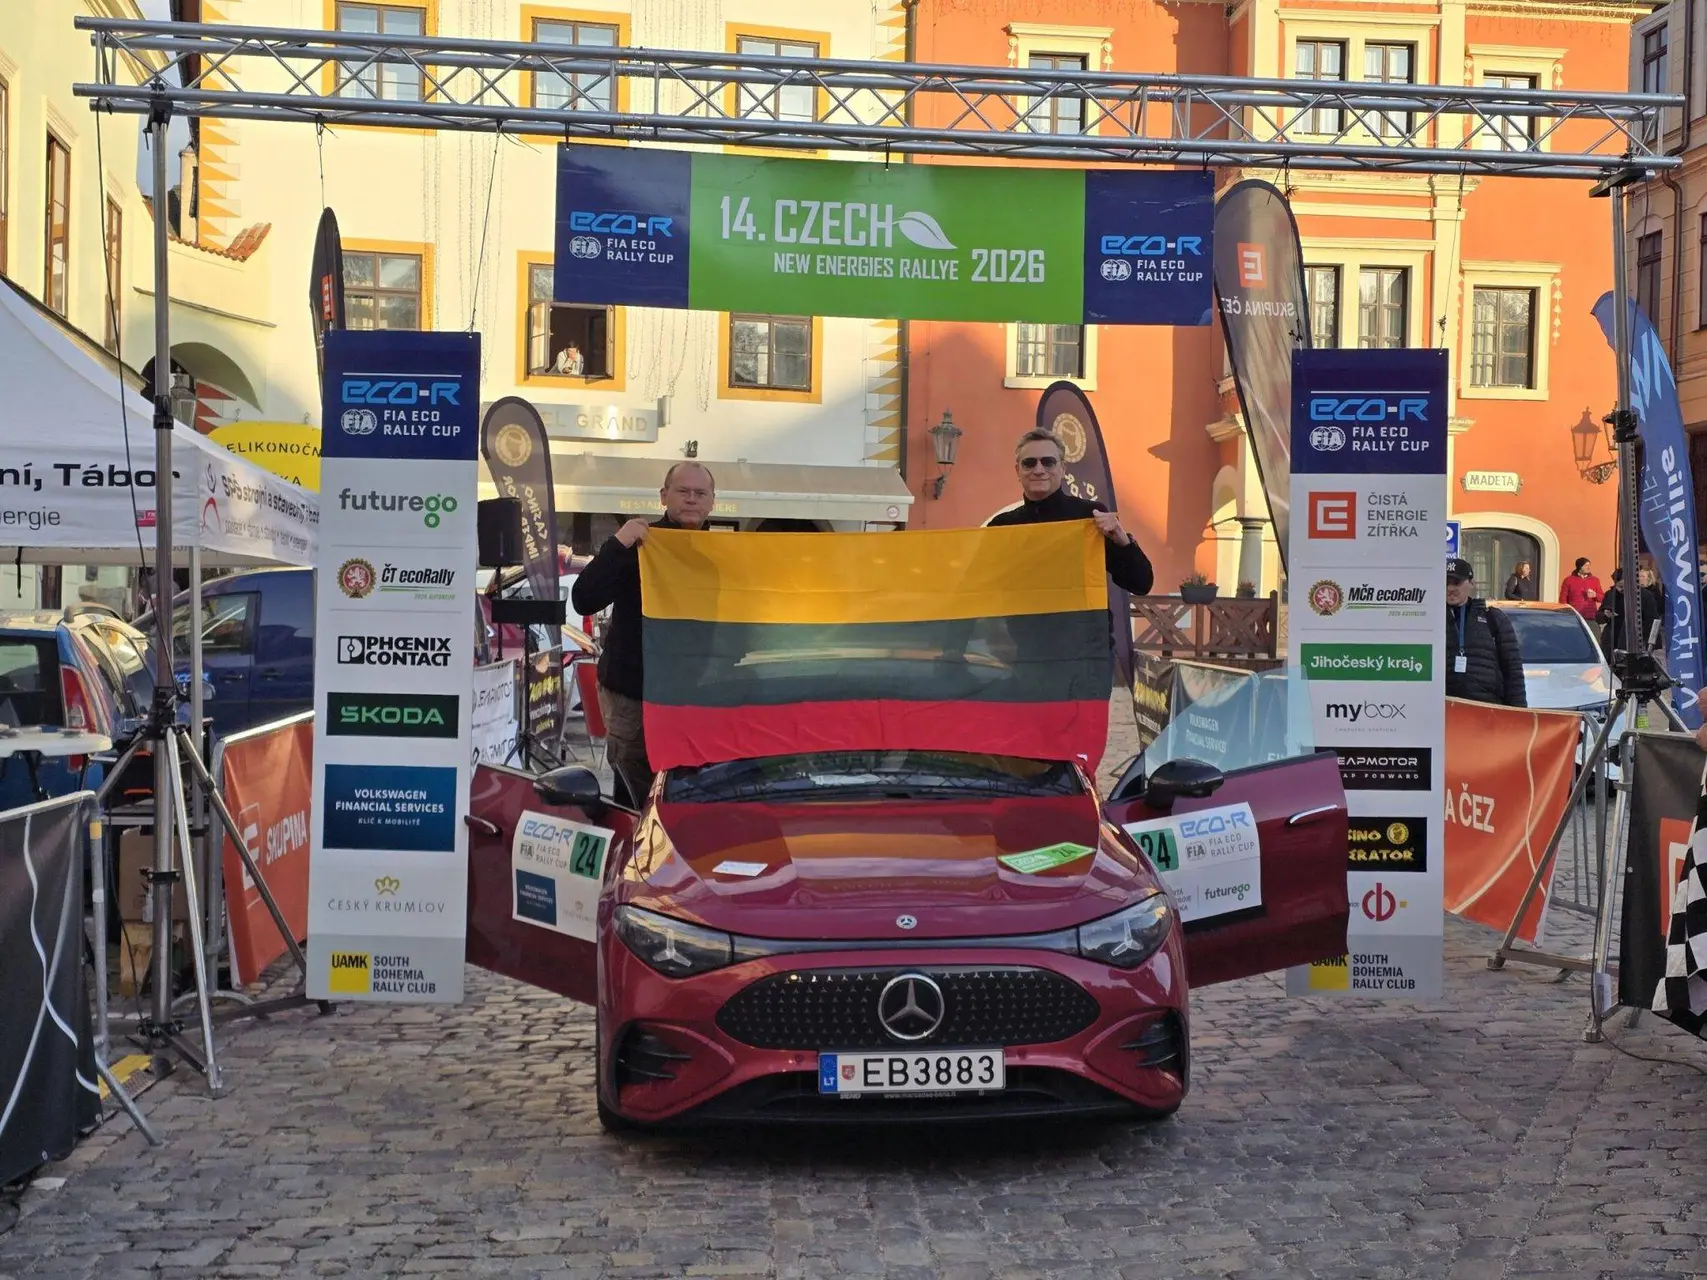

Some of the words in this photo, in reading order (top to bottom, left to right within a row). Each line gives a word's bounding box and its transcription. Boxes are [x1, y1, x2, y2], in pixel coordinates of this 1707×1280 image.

[720, 195, 766, 241] 14.
[774, 199, 893, 248] CZECH
[607, 238, 628, 249] FIA
[631, 239, 656, 251] ECO
[607, 250, 646, 262] RALLY
[649, 252, 674, 264] CUP
[774, 252, 810, 274] NEW
[817, 254, 894, 278] ENERGIES
[900, 257, 959, 281] RALLYE
[971, 248, 1045, 284] 2026
[1137, 259, 1158, 270] FIA
[1161, 259, 1186, 270] ECO
[1137, 271, 1176, 282] RALLY
[1178, 271, 1203, 282] CUP
[384, 410, 407, 421] FIA
[412, 410, 440, 422] ECO
[576, 413, 648, 432] GRAND
[384, 425, 428, 436] RALLY
[432, 425, 461, 437] CUP
[1352, 426, 1375, 437] FIA
[1380, 426, 1408, 437] ECO
[227, 441, 322, 458] ELIKONOČN
[1352, 440, 1397, 451] RALLY
[1400, 440, 1430, 451] CUP
[1469, 475, 1515, 487] MADETA
[1367, 491, 1408, 506] ČISTÁ
[338, 488, 458, 528] futurego
[1367, 510, 1428, 522] ENERGIE
[1367, 524, 1418, 537] ZÍTŘKA
[381, 564, 398, 583] ČT
[399, 568, 455, 586] ecoRally
[1348, 583, 1375, 602] MČR
[1376, 587, 1427, 603] ecoRally
[365, 651, 452, 667] CONTACT
[1310, 654, 1384, 671] Jihočeský
[1387, 656, 1415, 671] kraj
[1337, 756, 1418, 766] EAPMOTOR
[354, 788, 427, 800] VOLKSWAGEN
[335, 801, 392, 812] FINANCIAL
[395, 802, 444, 813] SERVICES
[1459, 783, 1495, 834] ČEZ
[266, 810, 308, 866] SKUPINA
[1209, 837, 1223, 846] FIA
[1225, 833, 1242, 844] ECO
[1347, 829, 1382, 842] SINO
[575, 835, 600, 876] 24
[1140, 832, 1171, 869] 24
[1210, 846, 1236, 857] RALLY
[1238, 841, 1255, 851] CUP
[1348, 848, 1414, 861] ERATOR
[1204, 884, 1250, 901] futurego
[328, 899, 369, 911] ČESKÝ
[375, 901, 445, 913] KRUMLOV
[331, 954, 368, 969] UAMK
[374, 956, 410, 967] SOUTH
[1352, 954, 1388, 965] SOUTH
[373, 969, 424, 980] BOHEMIA
[1352, 966, 1404, 977] BOHEMIA
[373, 982, 404, 993] RALLY
[407, 982, 436, 994] CLUB
[1352, 979, 1384, 989] RALLY
[1387, 979, 1416, 990] CLUB
[863, 1055, 995, 1087] EB3883
[823, 1077, 835, 1087] LT
